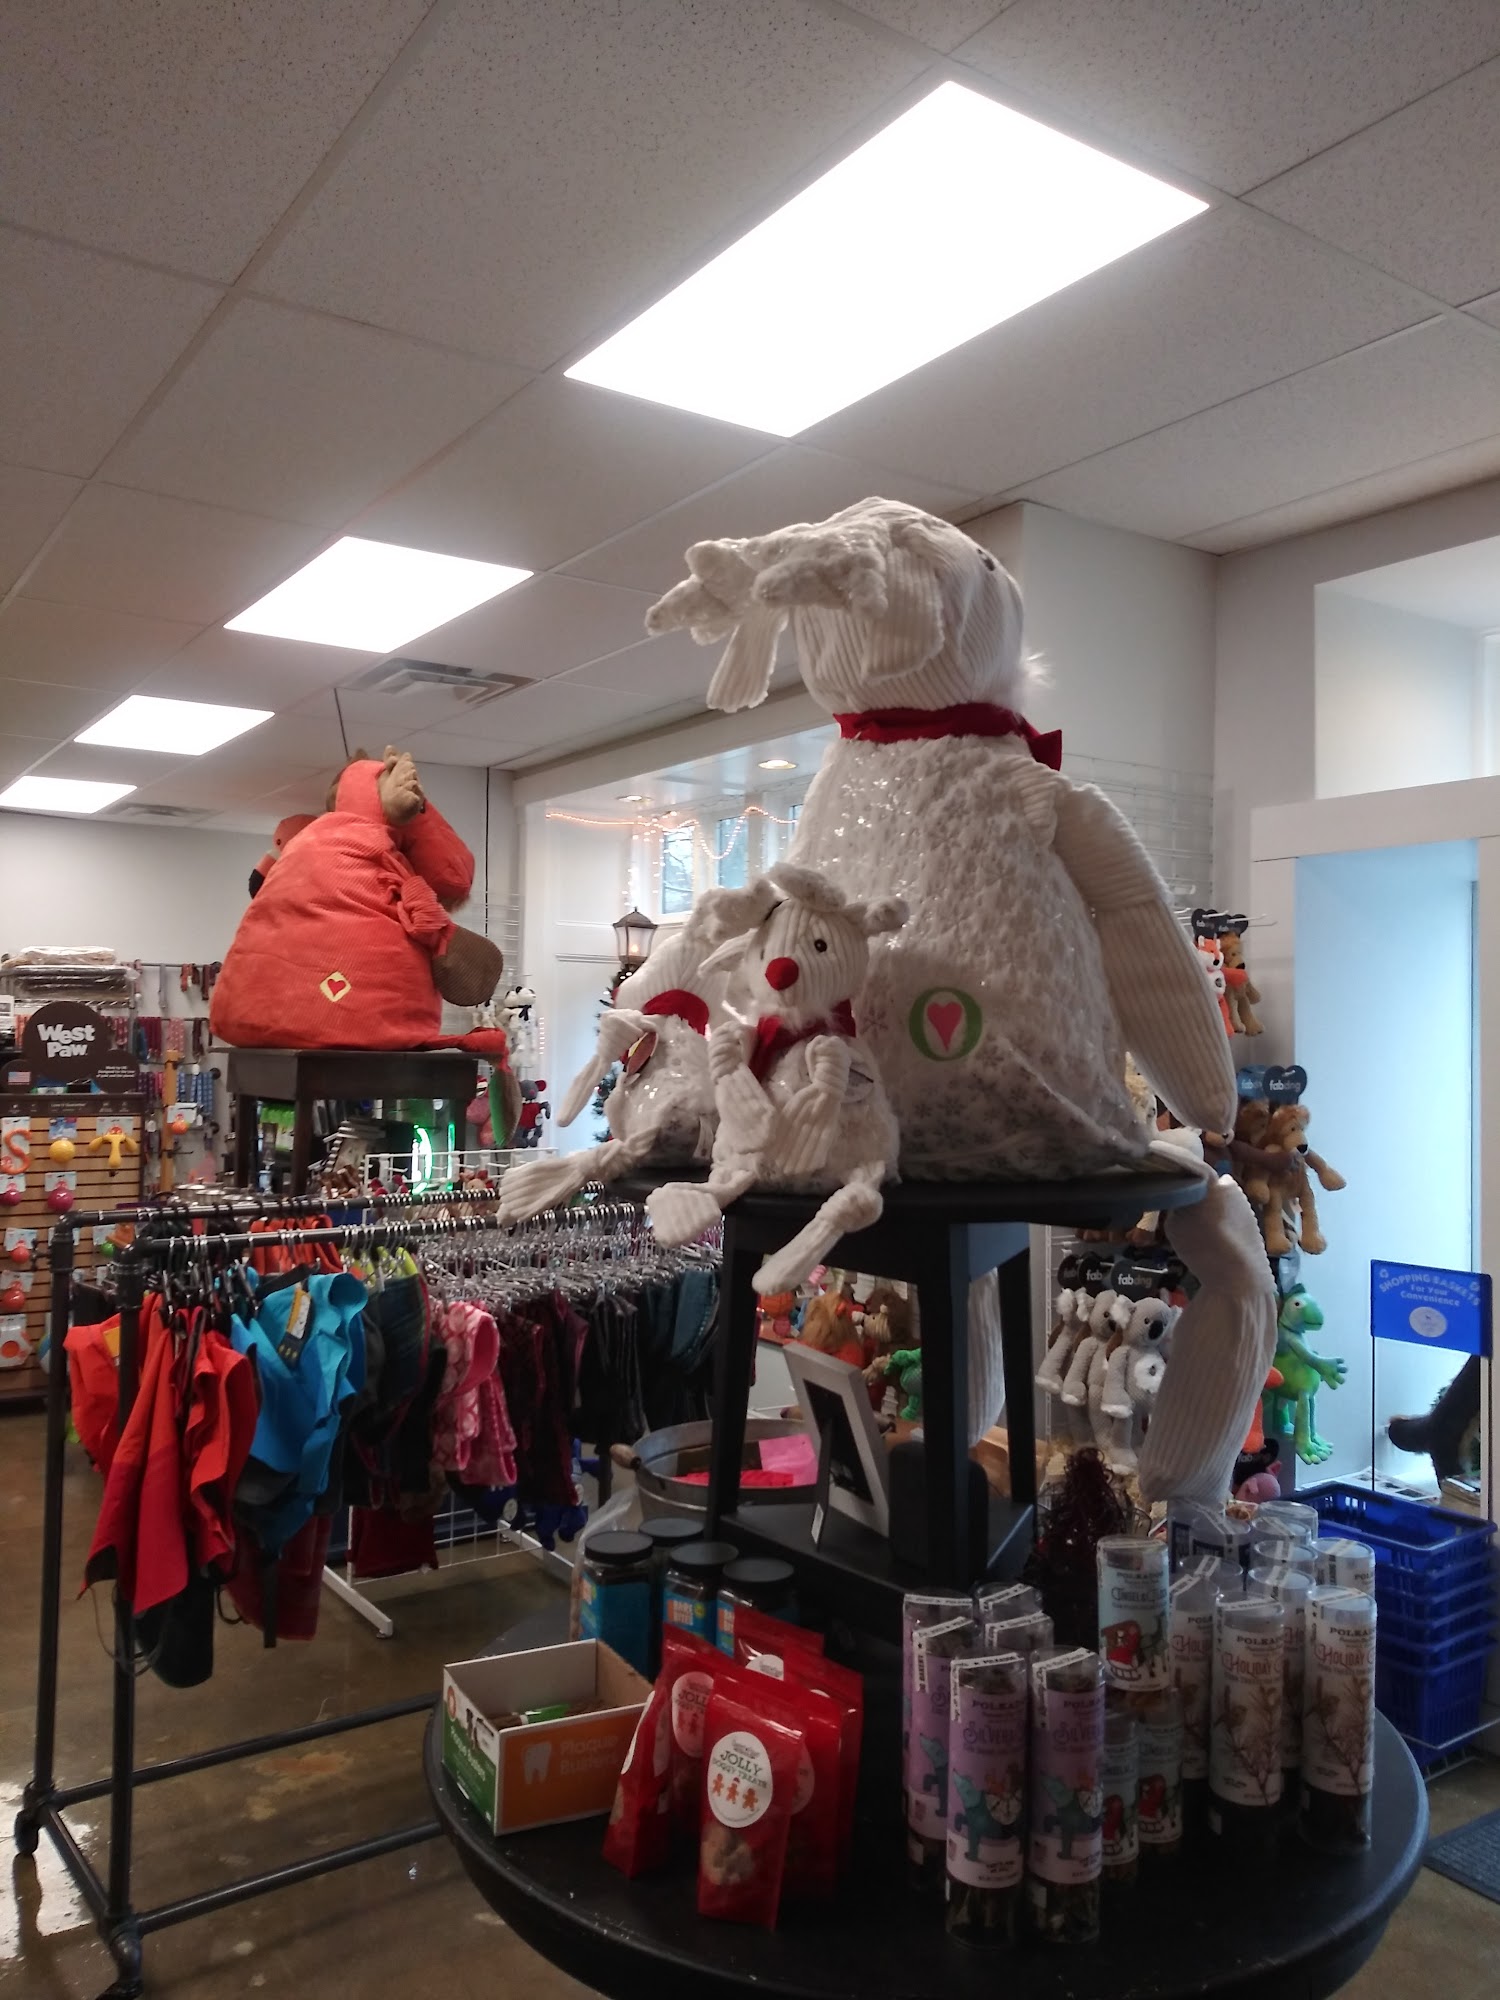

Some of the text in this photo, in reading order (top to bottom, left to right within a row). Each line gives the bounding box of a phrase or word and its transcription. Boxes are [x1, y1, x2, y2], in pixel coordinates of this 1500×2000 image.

[37, 1023, 96, 1045] West
[46, 1041, 88, 1058] Paw
[1379, 1273, 1480, 1306] SHOPPING BASKETS
[1400, 1290, 1460, 1306] Convenience
[1411, 1284, 1448, 1296] For Your
[1221, 1651, 1272, 1677] HOLIDAY
[1316, 1643, 1366, 1669] HOLIDAY
[677, 1688, 708, 1705] JOLL
[720, 1750, 763, 1776] JOLLY
